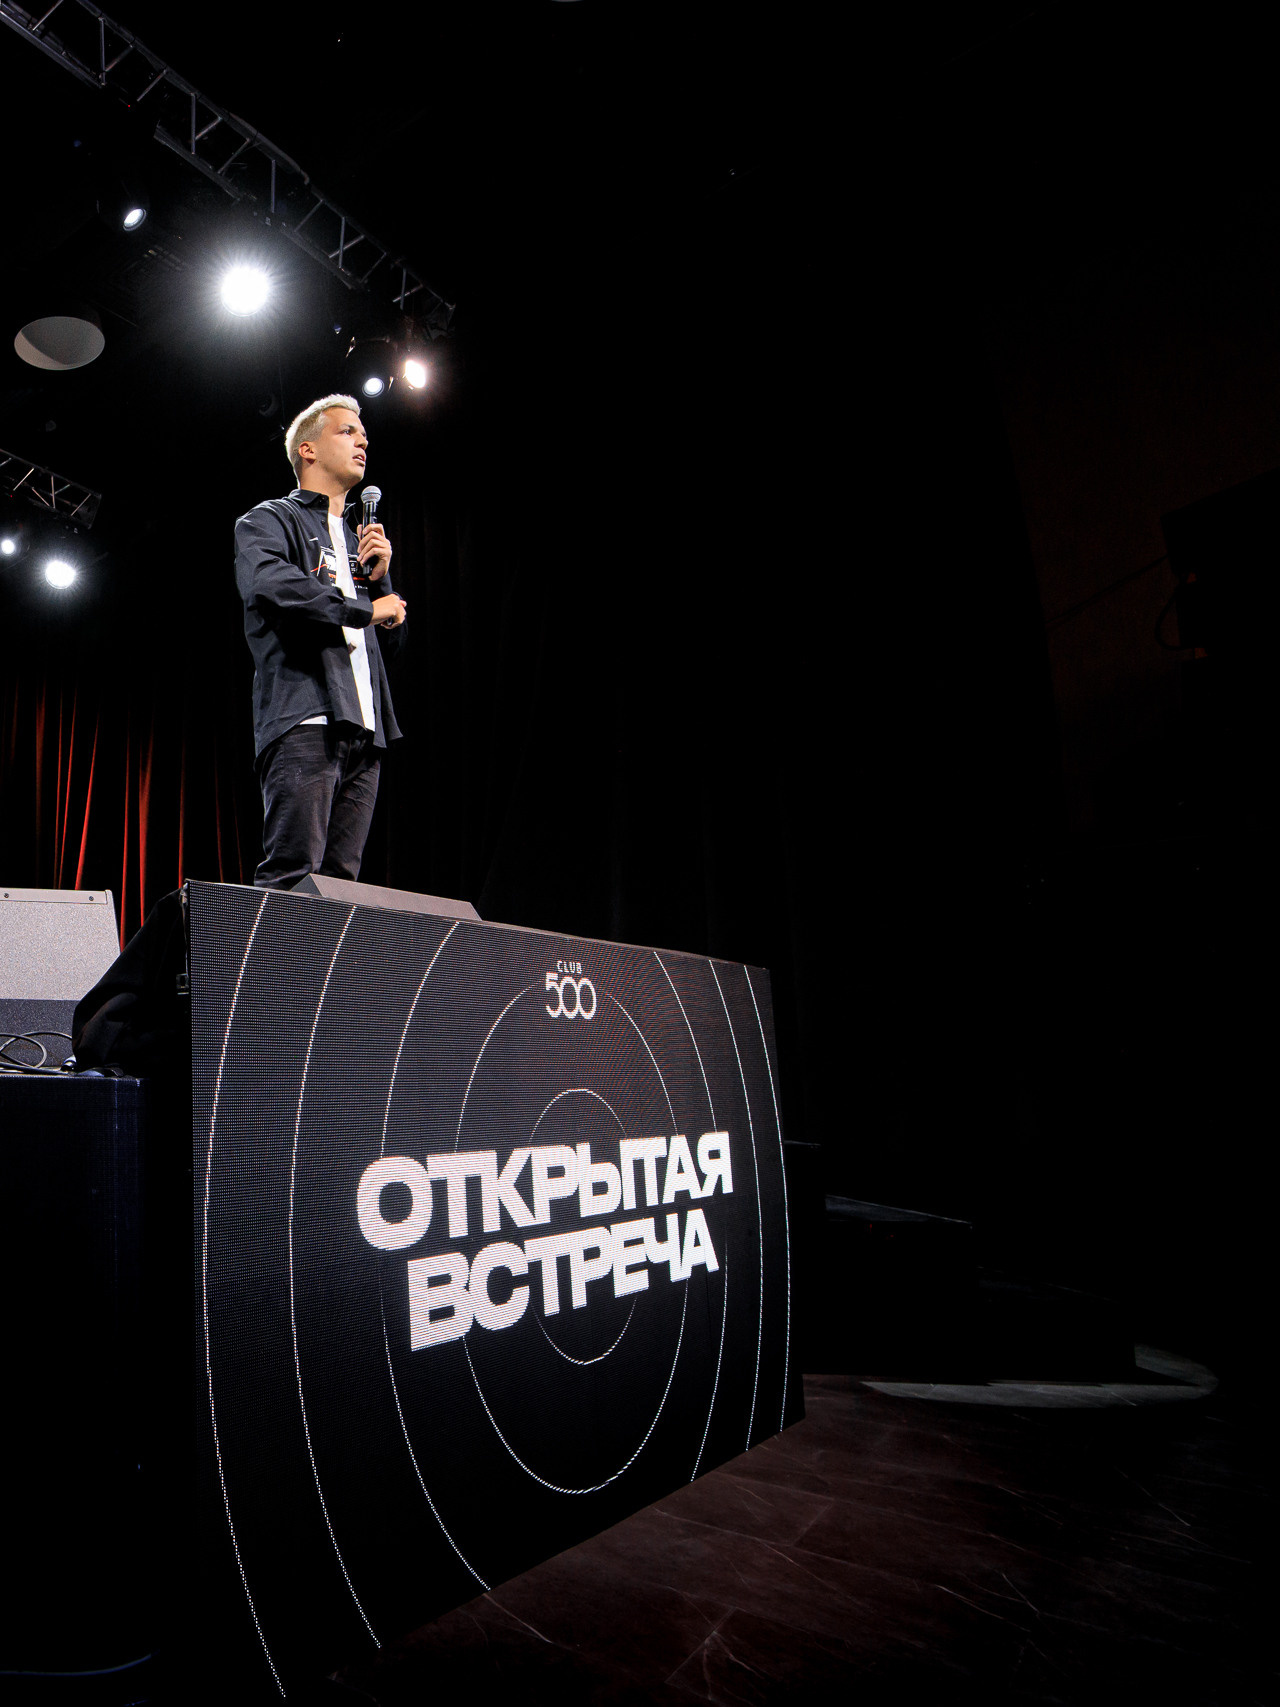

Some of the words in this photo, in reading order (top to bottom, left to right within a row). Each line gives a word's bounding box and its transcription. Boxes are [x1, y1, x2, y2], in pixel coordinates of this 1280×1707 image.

[545, 972, 597, 1019] 500
[556, 960, 583, 974] CLUB
[356, 1131, 734, 1250] ОТКРЫТАЯ
[407, 1208, 719, 1352] ВСТРЕЧА
